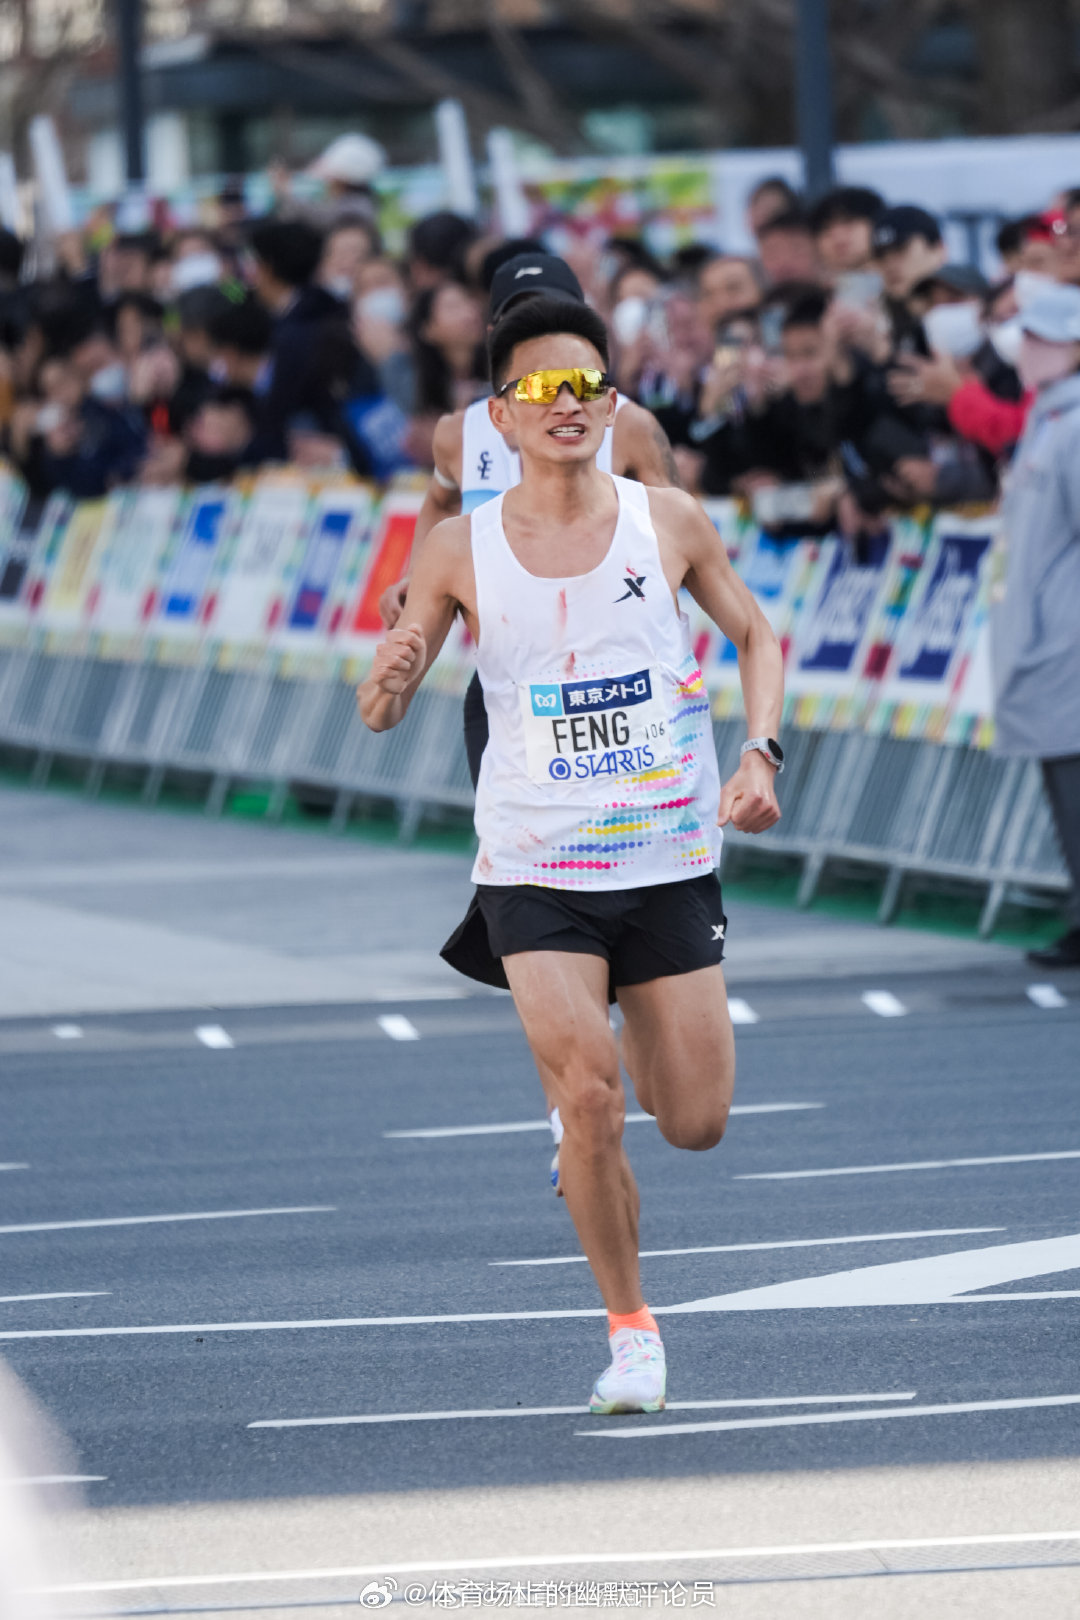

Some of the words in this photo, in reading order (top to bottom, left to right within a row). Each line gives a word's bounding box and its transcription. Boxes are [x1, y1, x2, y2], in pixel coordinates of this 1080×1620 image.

[567, 678, 647, 707] 東京メトロ
[551, 711, 630, 754] FENG
[644, 721, 666, 741] 106
